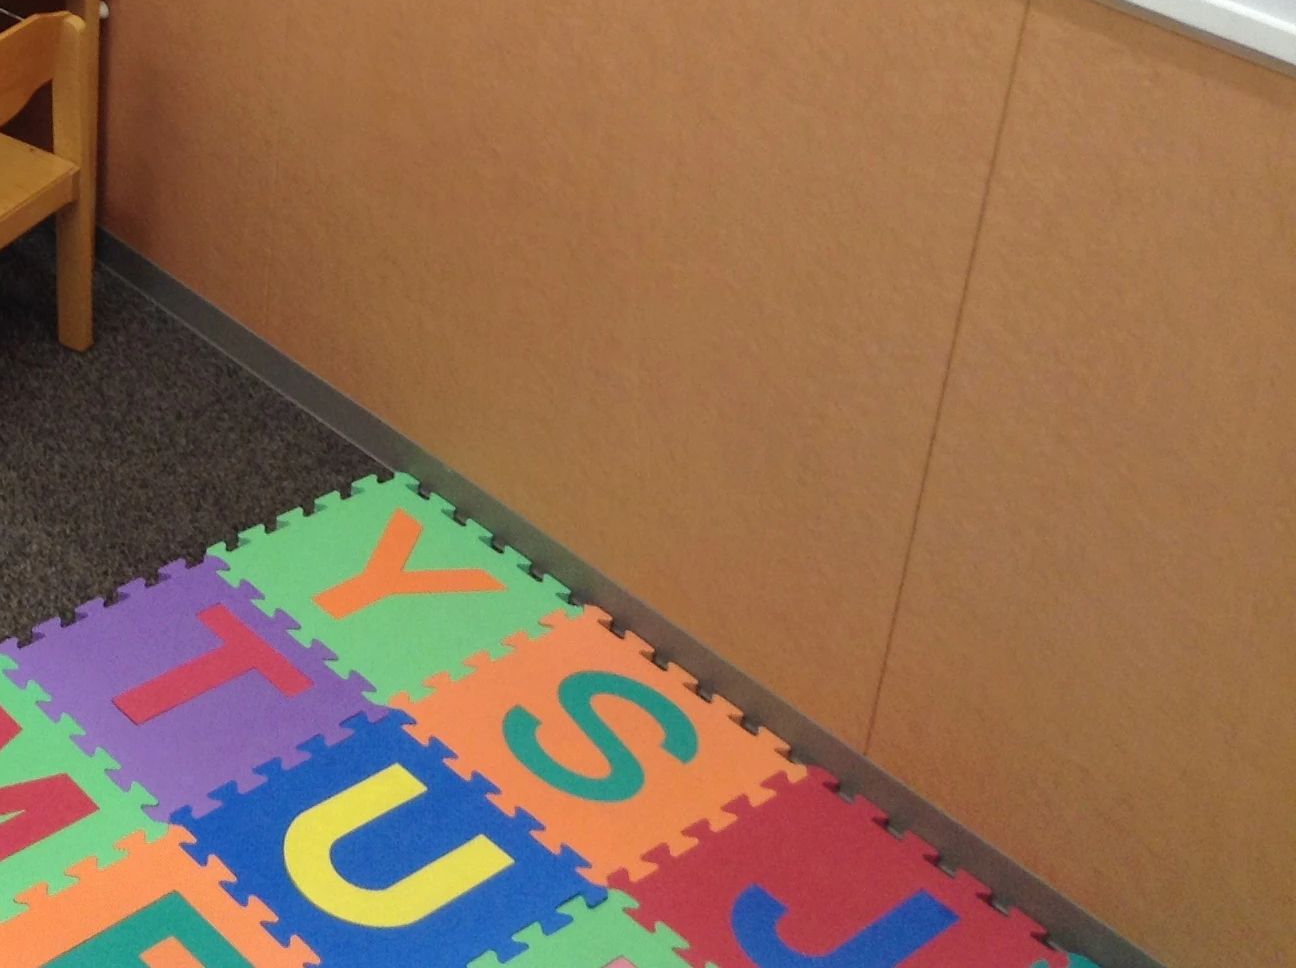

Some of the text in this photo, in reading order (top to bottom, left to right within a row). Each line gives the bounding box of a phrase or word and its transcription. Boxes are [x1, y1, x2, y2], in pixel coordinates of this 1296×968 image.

[313, 508, 506, 620] Y
[111, 602, 314, 726] T
[501, 670, 699, 803] S
[283, 763, 515, 928] U
